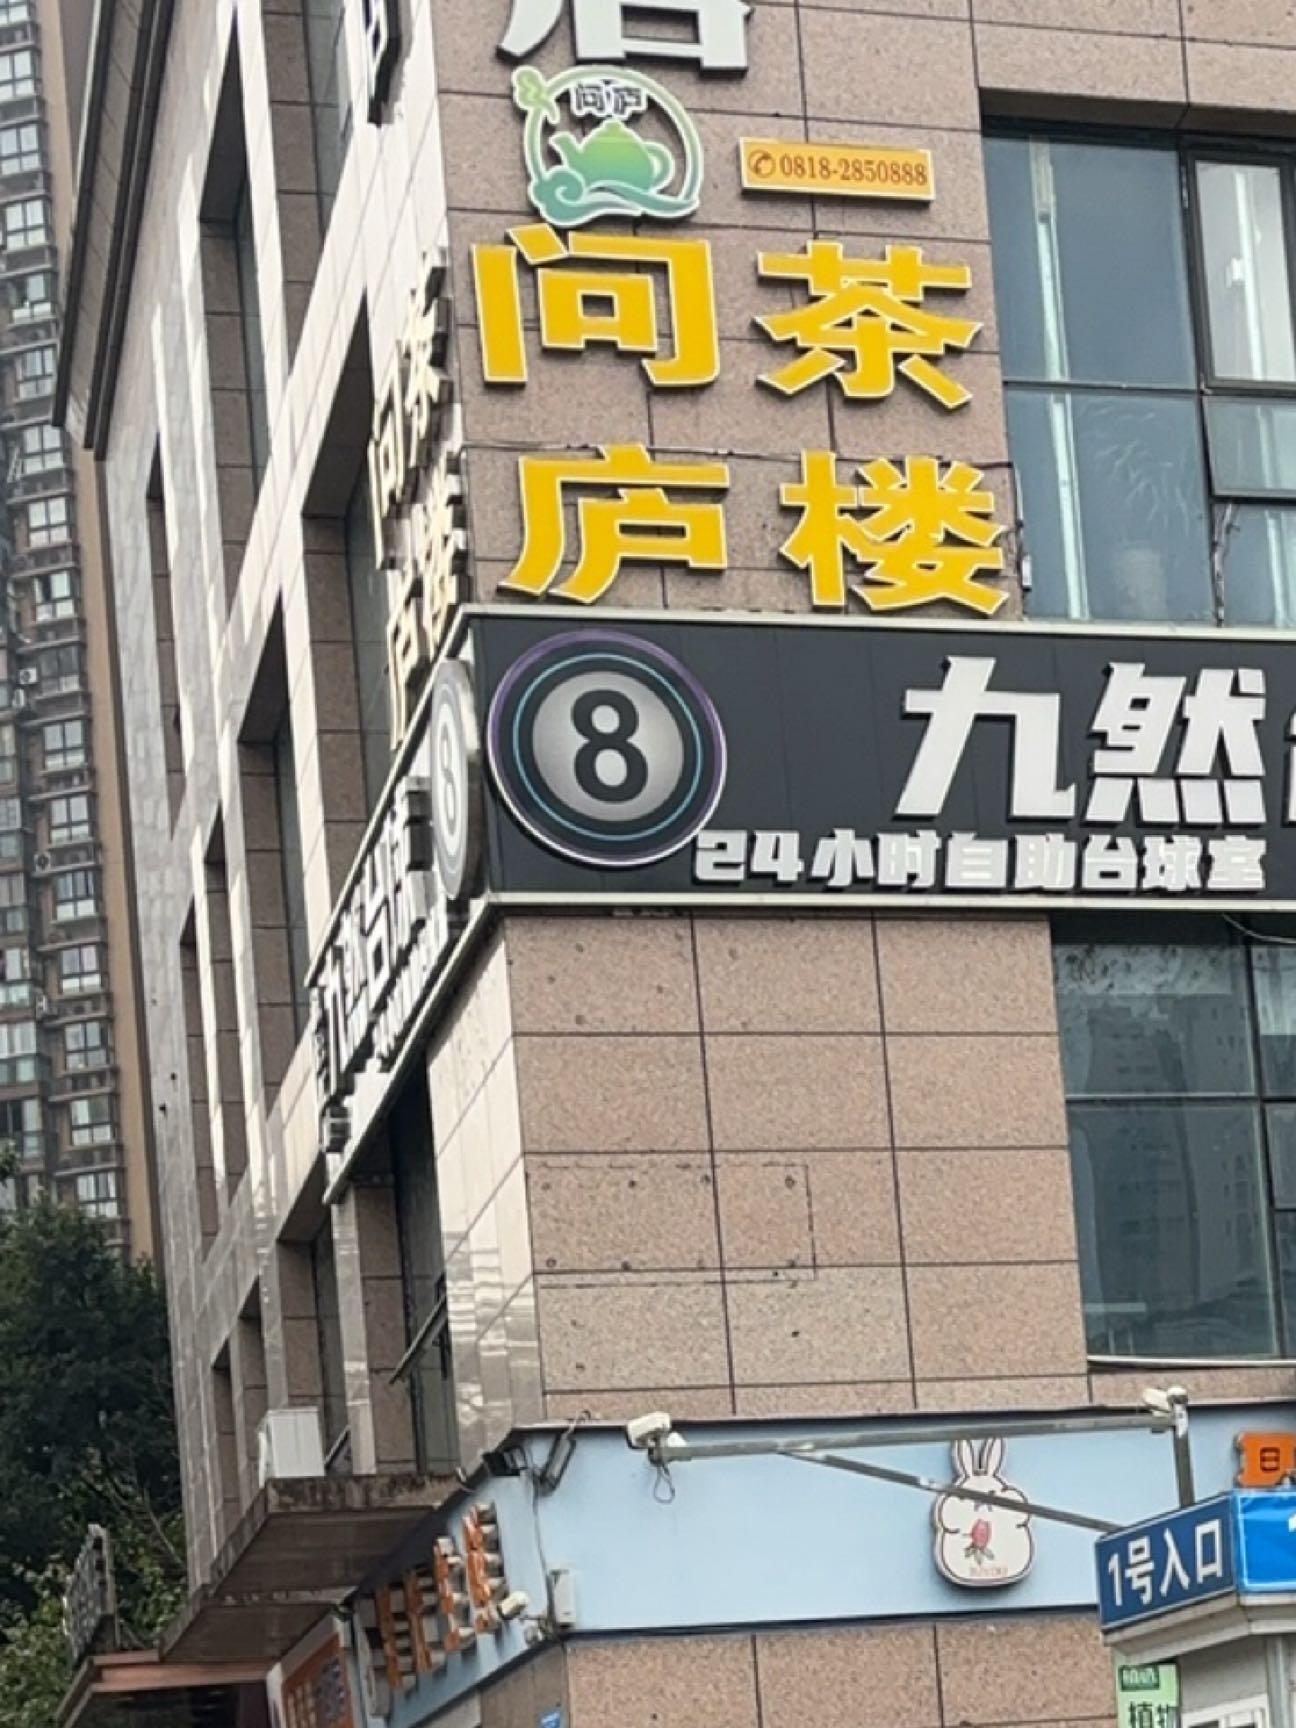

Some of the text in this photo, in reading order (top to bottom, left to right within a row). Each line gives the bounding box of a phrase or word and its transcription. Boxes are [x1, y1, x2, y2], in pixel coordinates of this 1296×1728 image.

[779, 151, 928, 187] 0818-2850888
[570, 688, 648, 802] 8
[693, 828, 1267, 892] 24小时自助台球室
[1108, 1519, 1223, 1606] 1号入口
